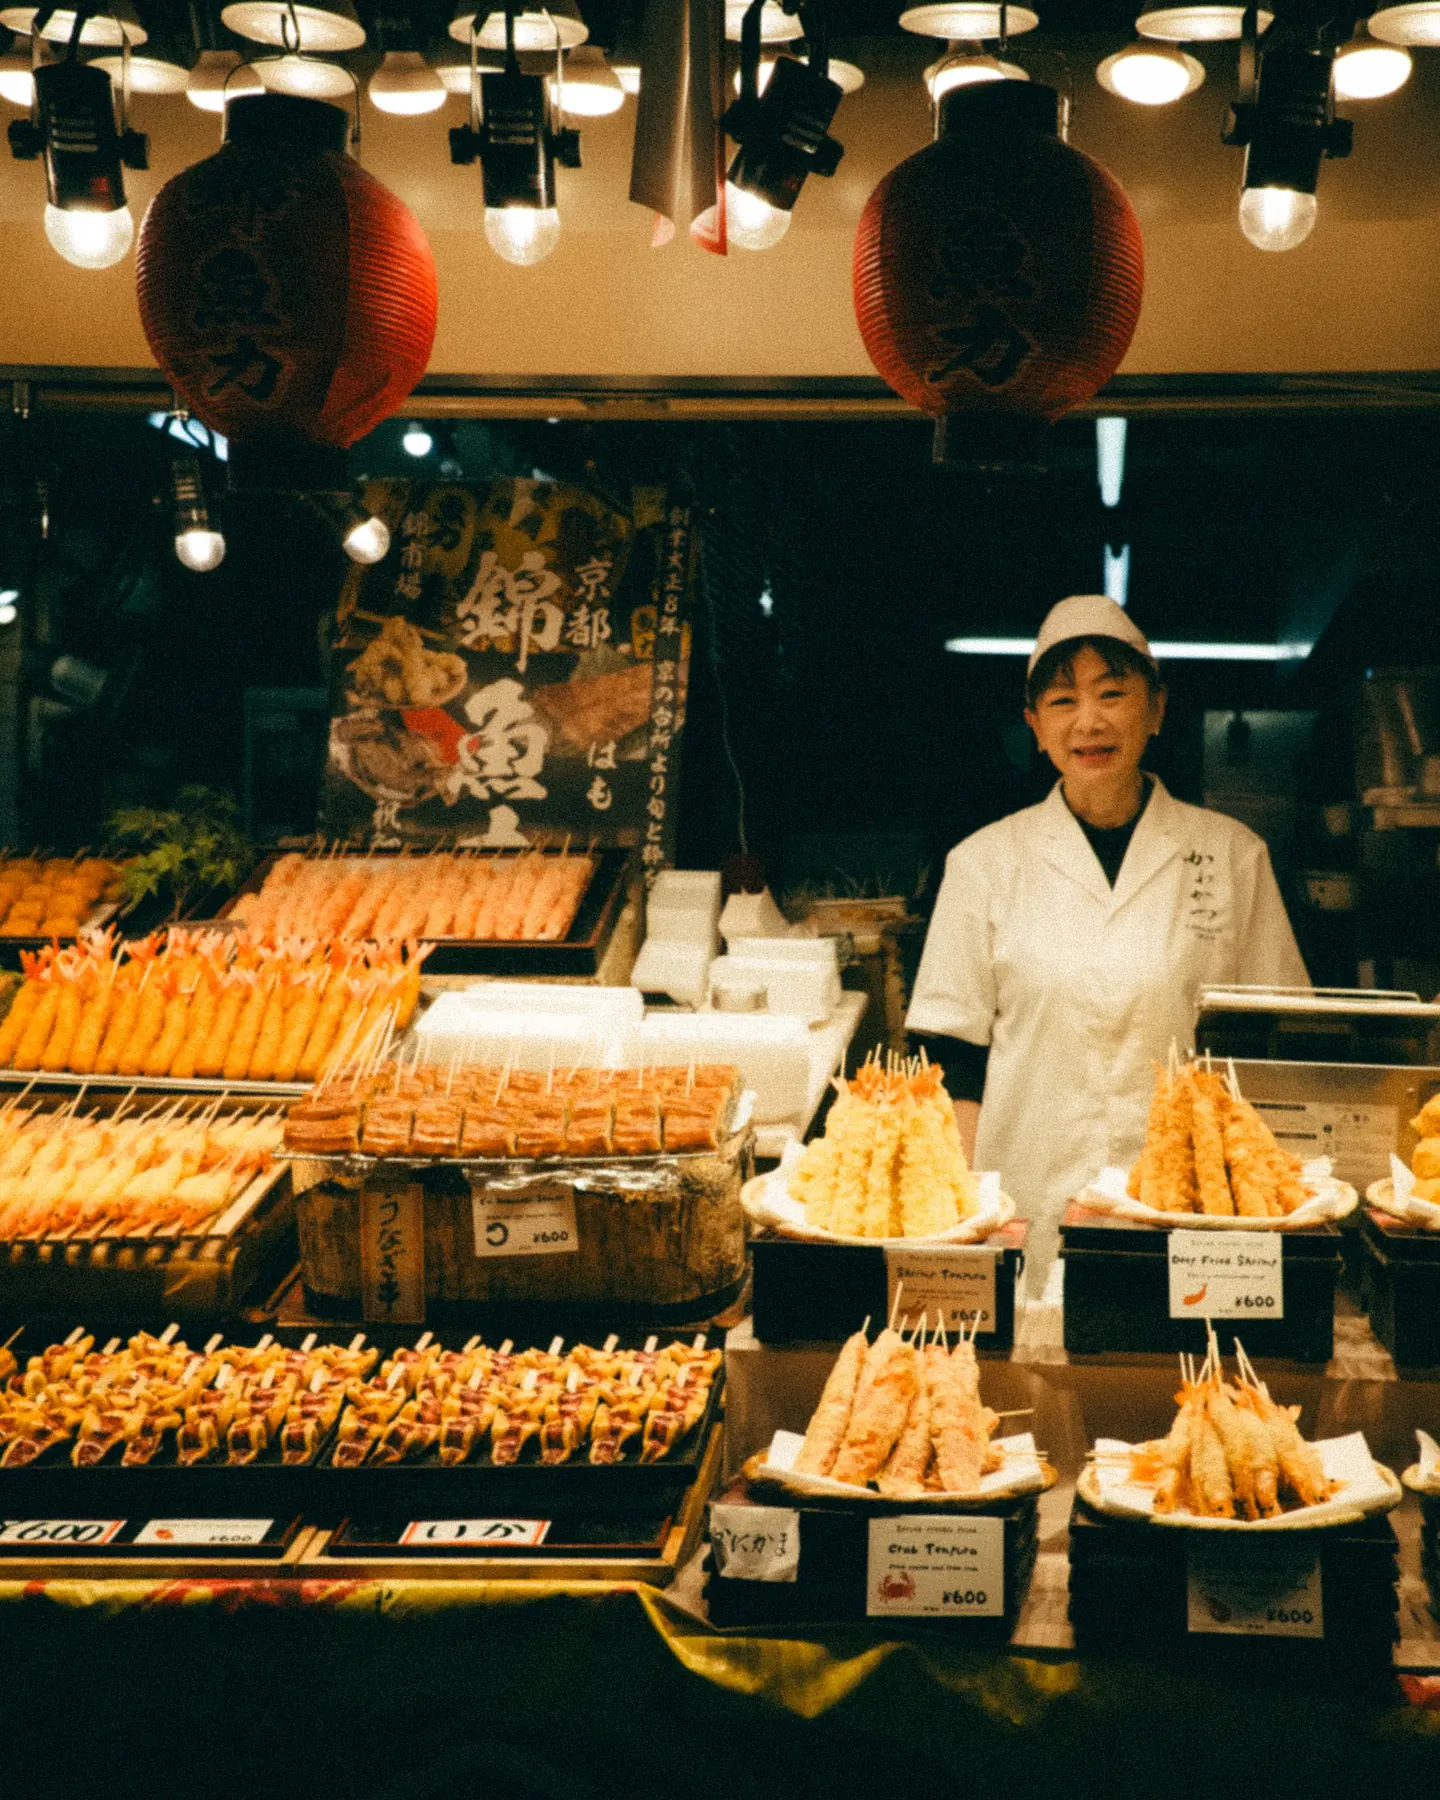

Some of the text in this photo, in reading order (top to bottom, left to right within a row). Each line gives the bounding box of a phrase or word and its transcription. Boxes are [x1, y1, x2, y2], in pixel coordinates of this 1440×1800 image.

[566, 556, 614, 648] 京都
[587, 740, 617, 812] はも
[1201, 1255, 1231, 1265] Fried
[1236, 1255, 1278, 1267] Shrimp
[1235, 1295, 1275, 1308] ¥600
[426, 1523, 526, 1539] いか
[888, 1544, 919, 1555] Crab
[943, 1589, 987, 1605] ¥600
[1267, 1607, 1313, 1624] ¥600
